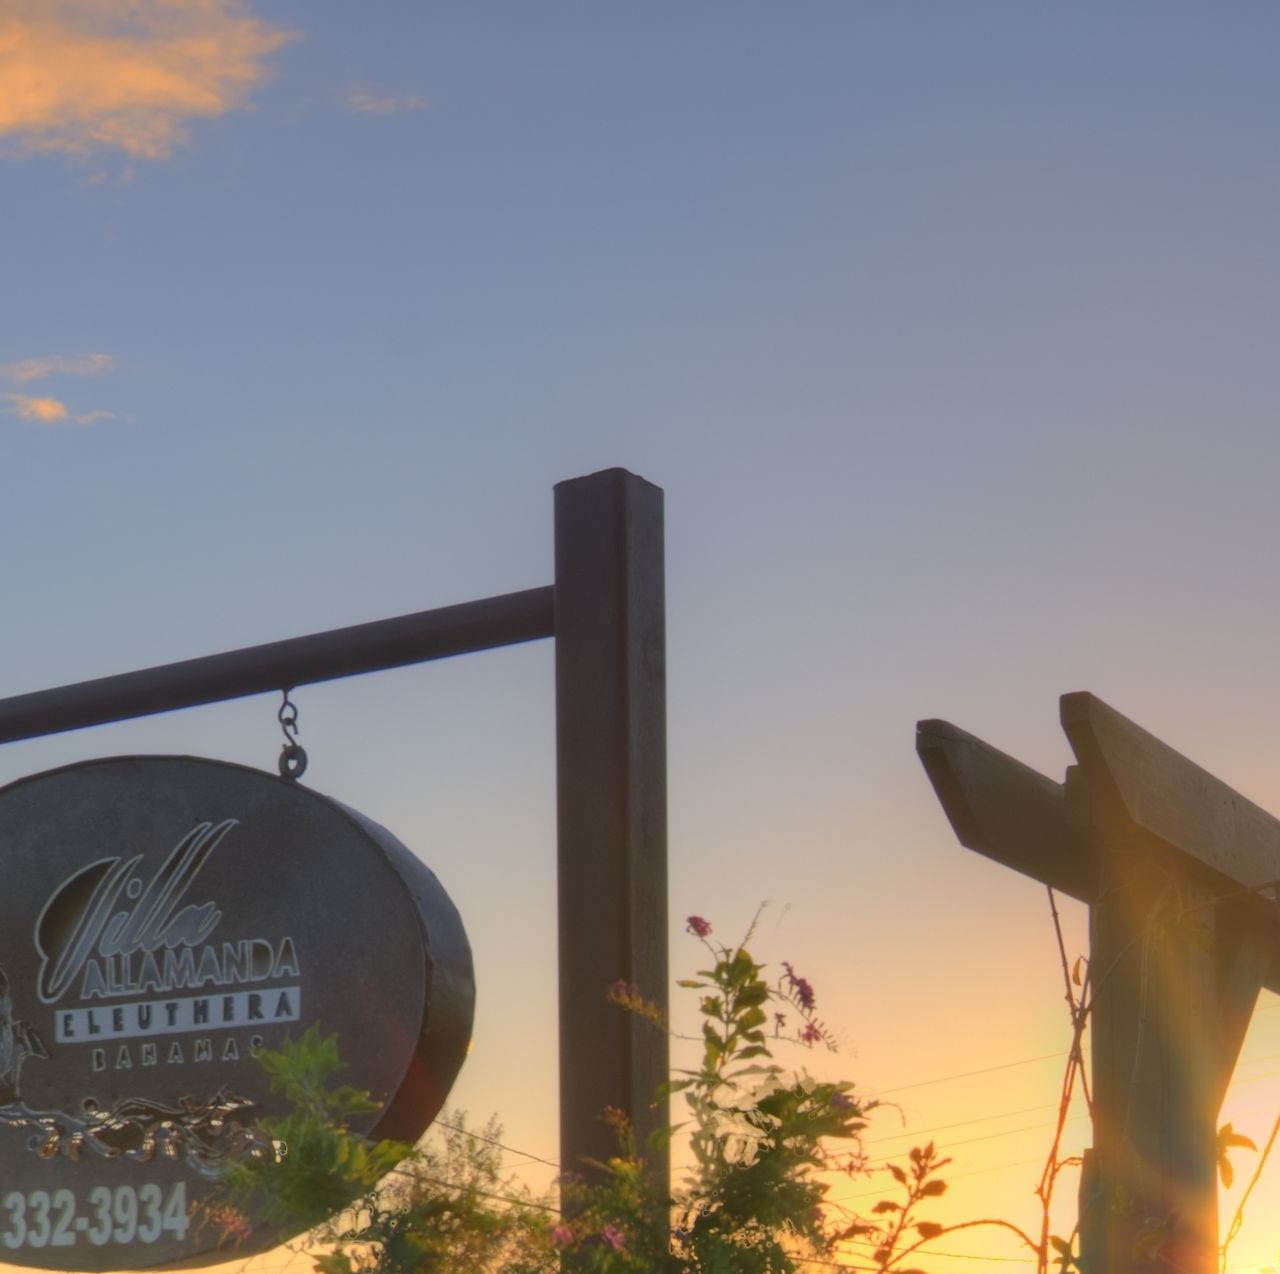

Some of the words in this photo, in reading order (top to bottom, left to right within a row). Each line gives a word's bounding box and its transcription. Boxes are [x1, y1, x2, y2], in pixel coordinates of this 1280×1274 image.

[34, 818, 240, 1004] Villa
[80, 936, 300, 1000] ALLAMANDA
[63, 991, 294, 1038] ELEUTHERA
[93, 1034, 265, 1072] BAHAMAS
[1, 1181, 190, 1249] 332-3934
